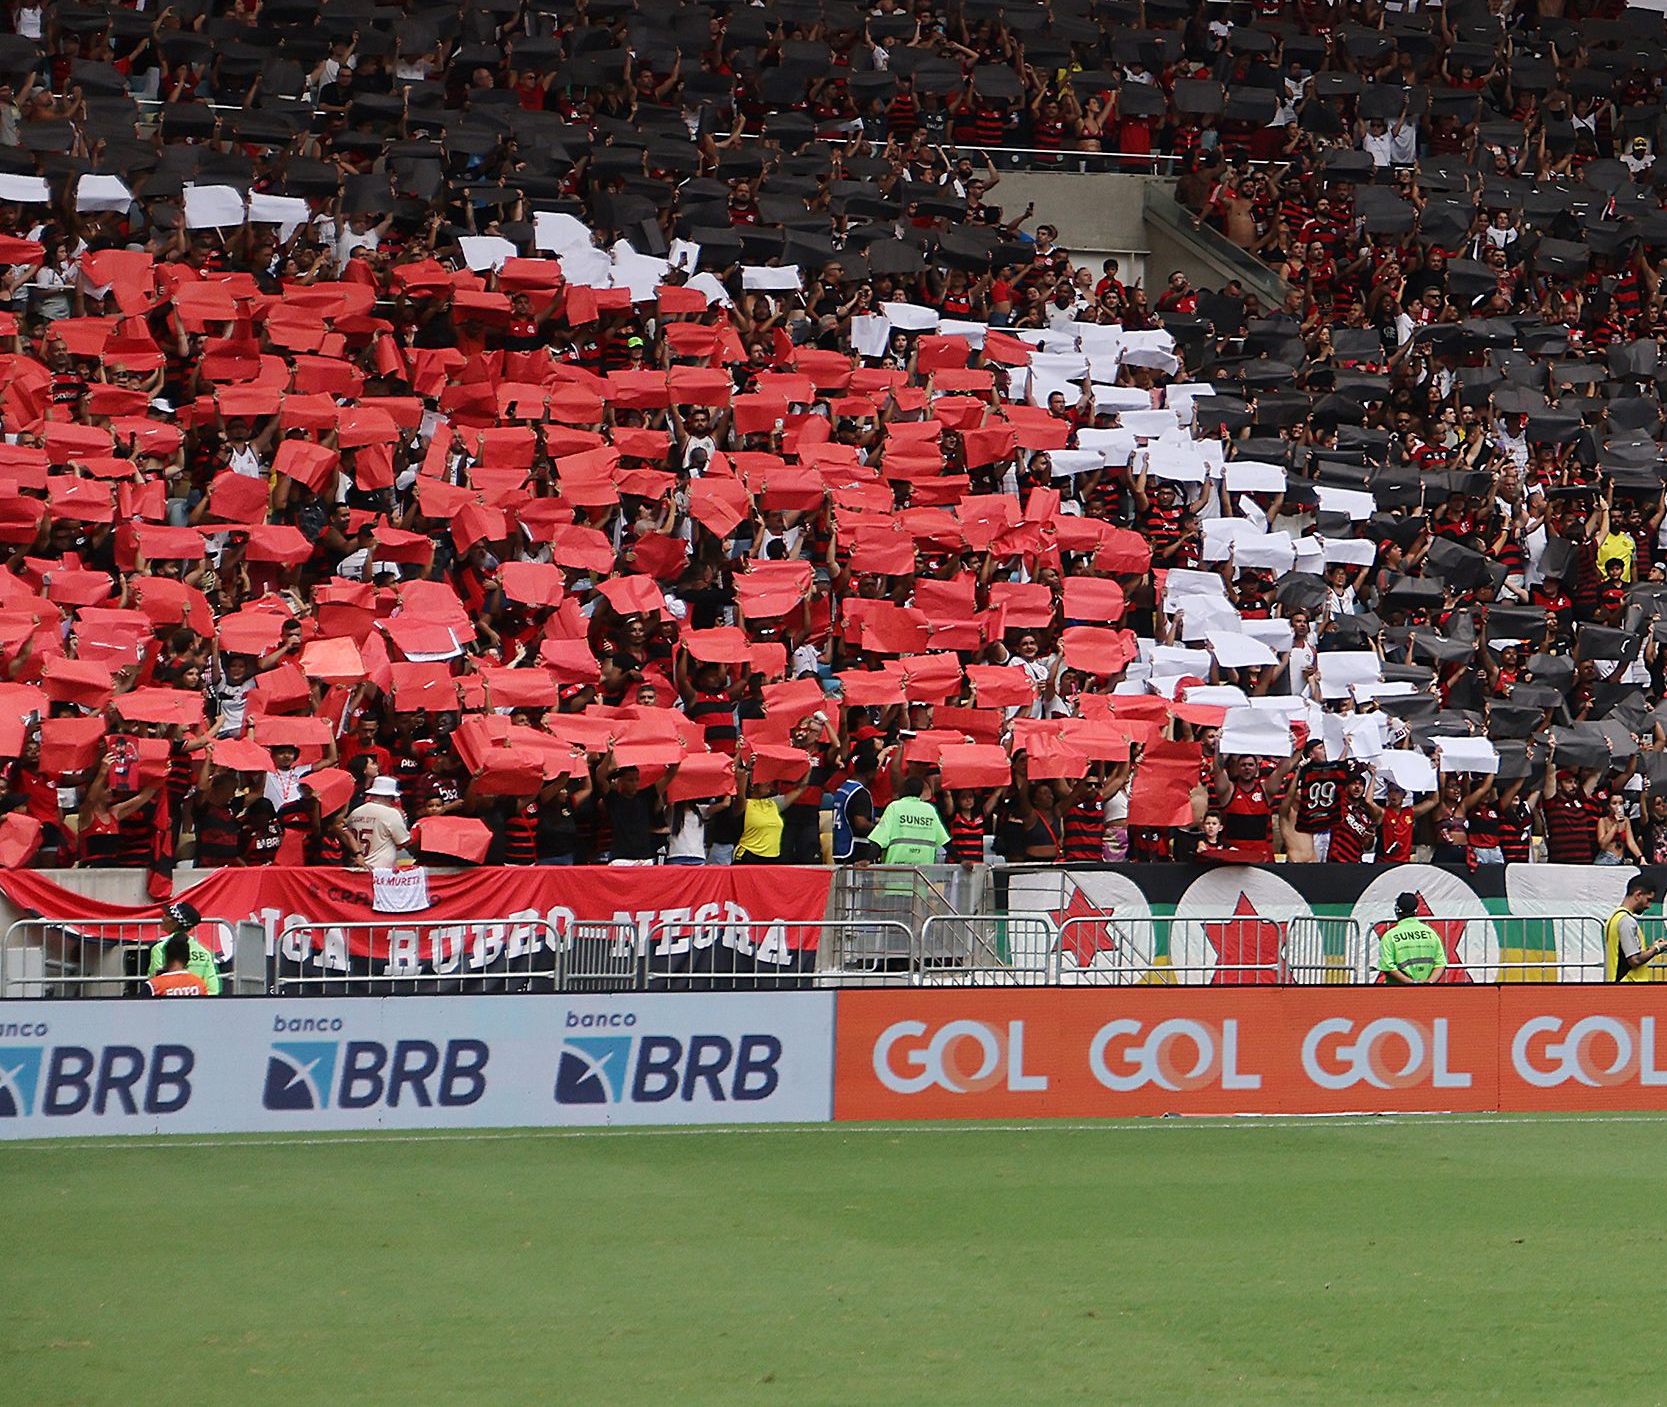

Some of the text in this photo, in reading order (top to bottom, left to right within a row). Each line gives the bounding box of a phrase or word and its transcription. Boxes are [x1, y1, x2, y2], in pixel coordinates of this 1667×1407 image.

[1307, 781, 1337, 810] 99
[898, 815, 934, 827] SUNSET
[1392, 928, 1433, 944] SUNSET
[0, 1021, 49, 1038] anco
[273, 1014, 344, 1034] banco
[566, 1010, 638, 1029] banco
[338, 1039, 490, 1110] BRB
[631, 1034, 783, 1106] BRB
[872, 1019, 1049, 1095] GOL
[1089, 1018, 1263, 1092] GOL
[1301, 1016, 1473, 1090] GOL
[42, 1044, 195, 1118] BRB
